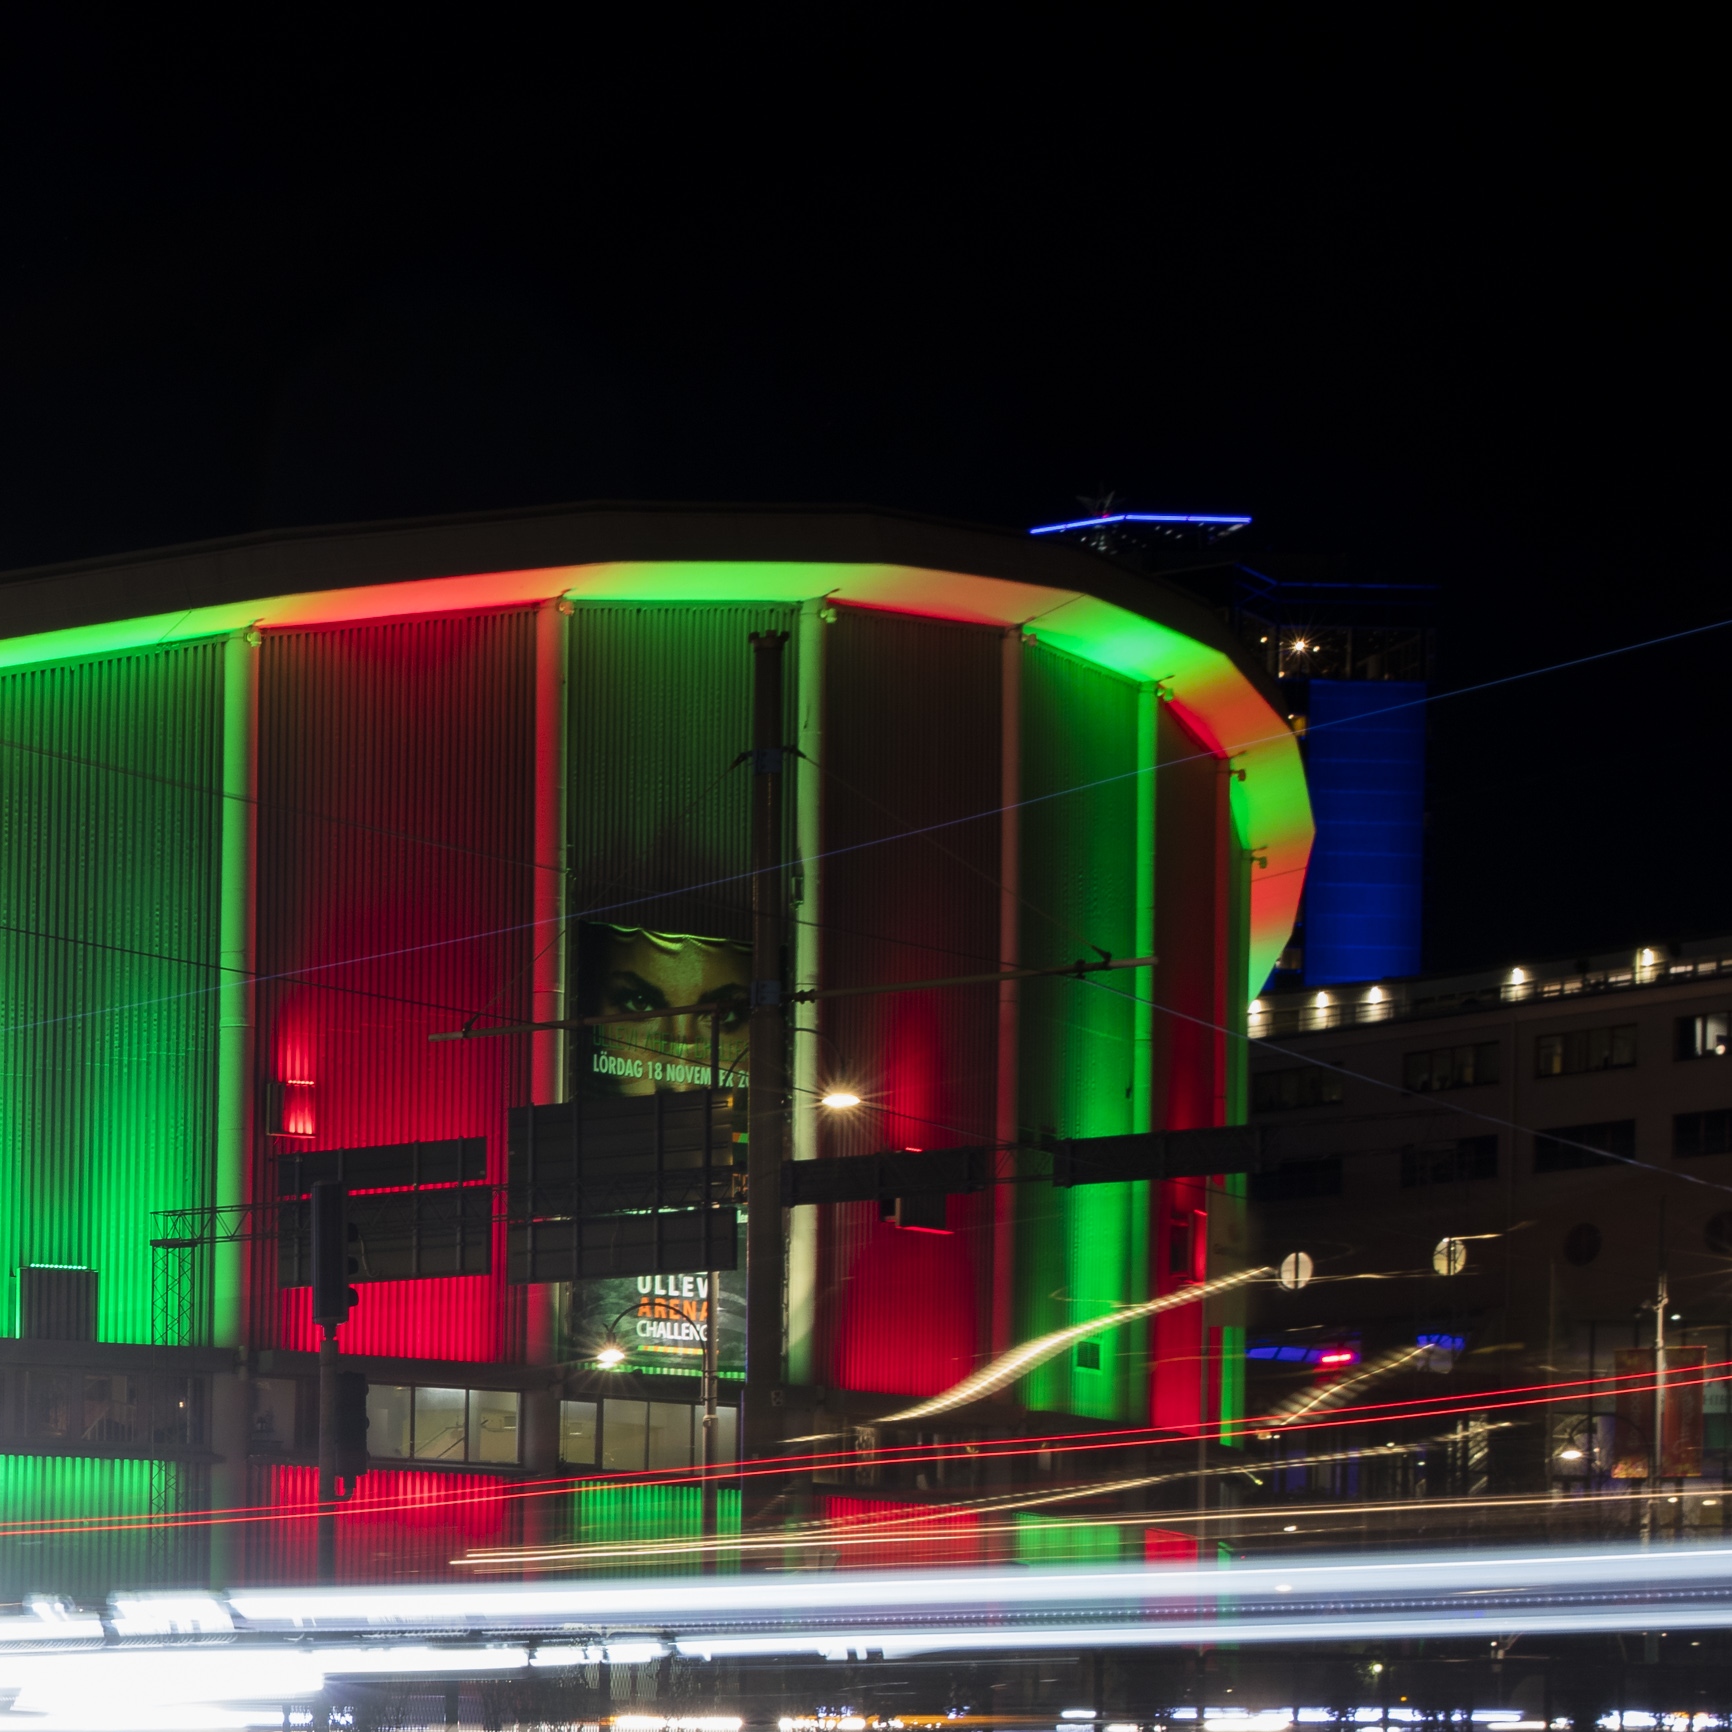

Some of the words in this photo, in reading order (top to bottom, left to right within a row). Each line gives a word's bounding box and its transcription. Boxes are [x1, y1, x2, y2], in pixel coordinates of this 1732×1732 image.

[593, 1051, 643, 1078] LÖRDAG
[648, 1062, 663, 1080] 18
[667, 1064, 734, 1087] NOVEMER
[637, 1275, 708, 1298] ULLEV
